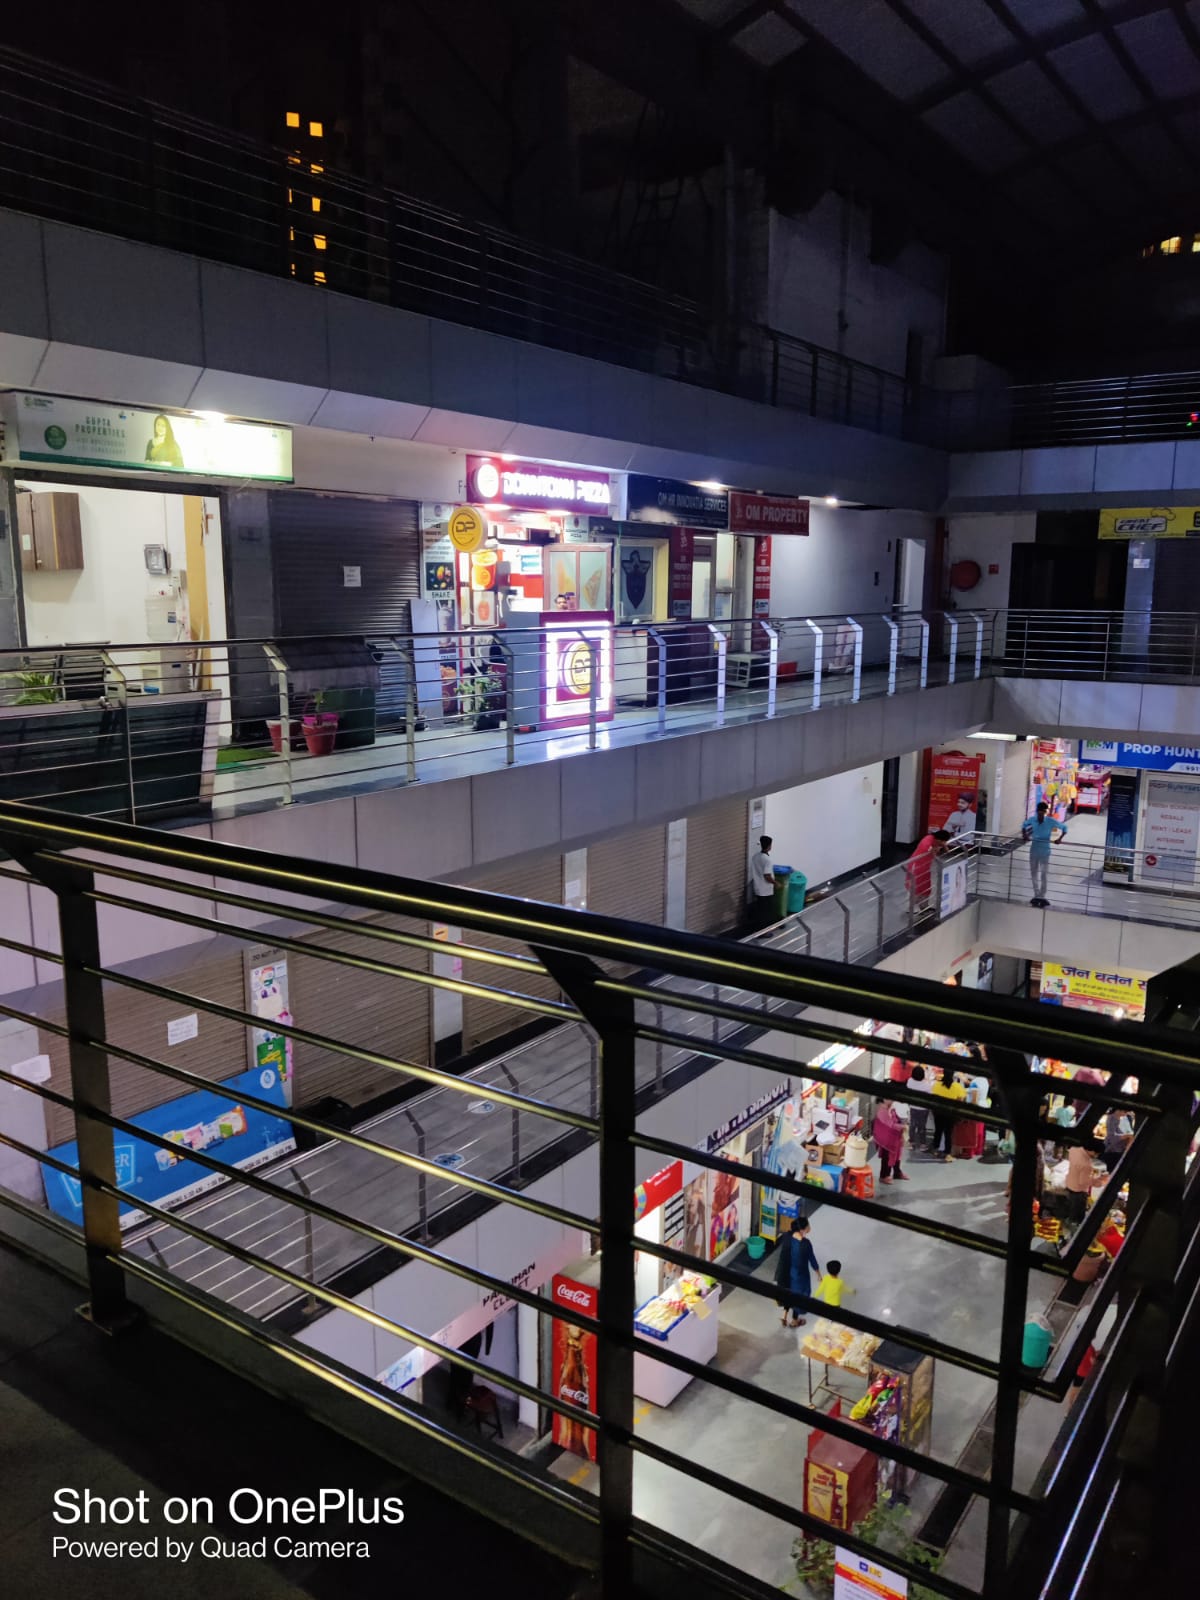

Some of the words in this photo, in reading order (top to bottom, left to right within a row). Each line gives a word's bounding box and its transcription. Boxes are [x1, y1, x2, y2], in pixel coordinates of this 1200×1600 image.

[85, 416, 111, 426] GUPTA
[75, 424, 126, 438] PROPERTIES
[502, 472, 575, 499] DOWNTOWN
[576, 479, 612, 504] PIZZA
[703, 497, 728, 513] SERVICES
[745, 504, 760, 520] OM
[762, 505, 809, 524] PROPERTY
[455, 521, 477, 533] DP
[1117, 522, 1164, 531] CHEF
[1123, 742, 1162, 755] PROP
